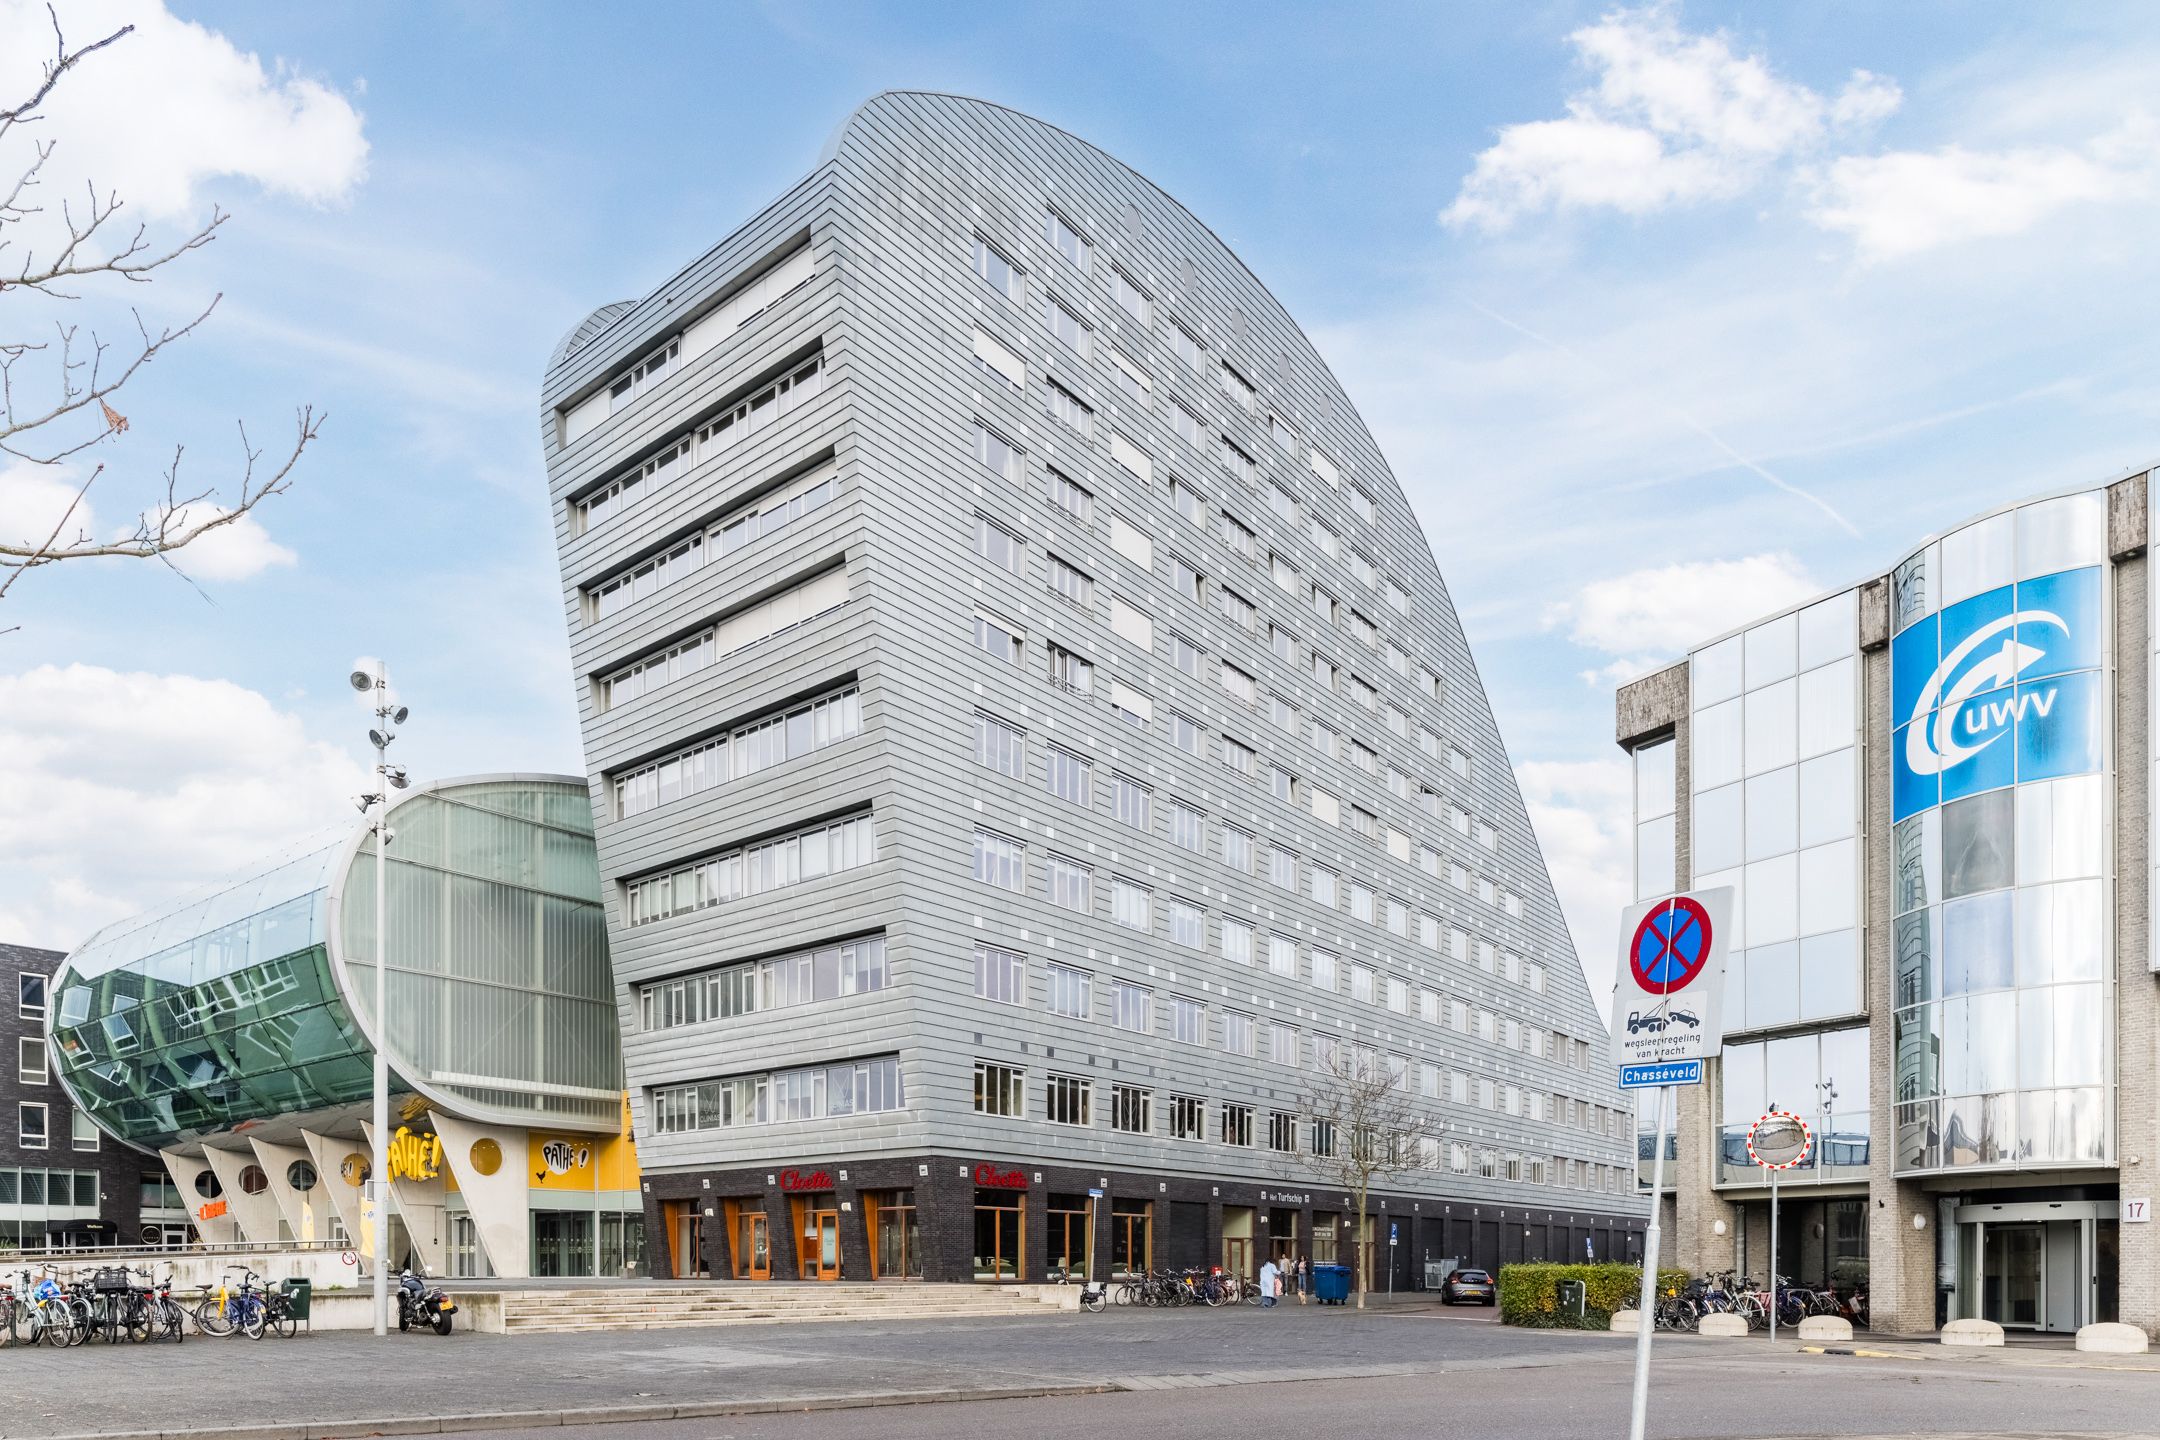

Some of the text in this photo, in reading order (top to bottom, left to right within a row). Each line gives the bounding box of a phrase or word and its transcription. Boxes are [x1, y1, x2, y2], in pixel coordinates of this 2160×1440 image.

[1966, 688, 2057, 734] uwv
[1636, 1046, 1685, 1058] van kracht
[1625, 1066, 1696, 1081] Chasséveld
[1278, 1192, 1302, 1204] Turfschip
[2128, 1203, 2144, 1217] 17
